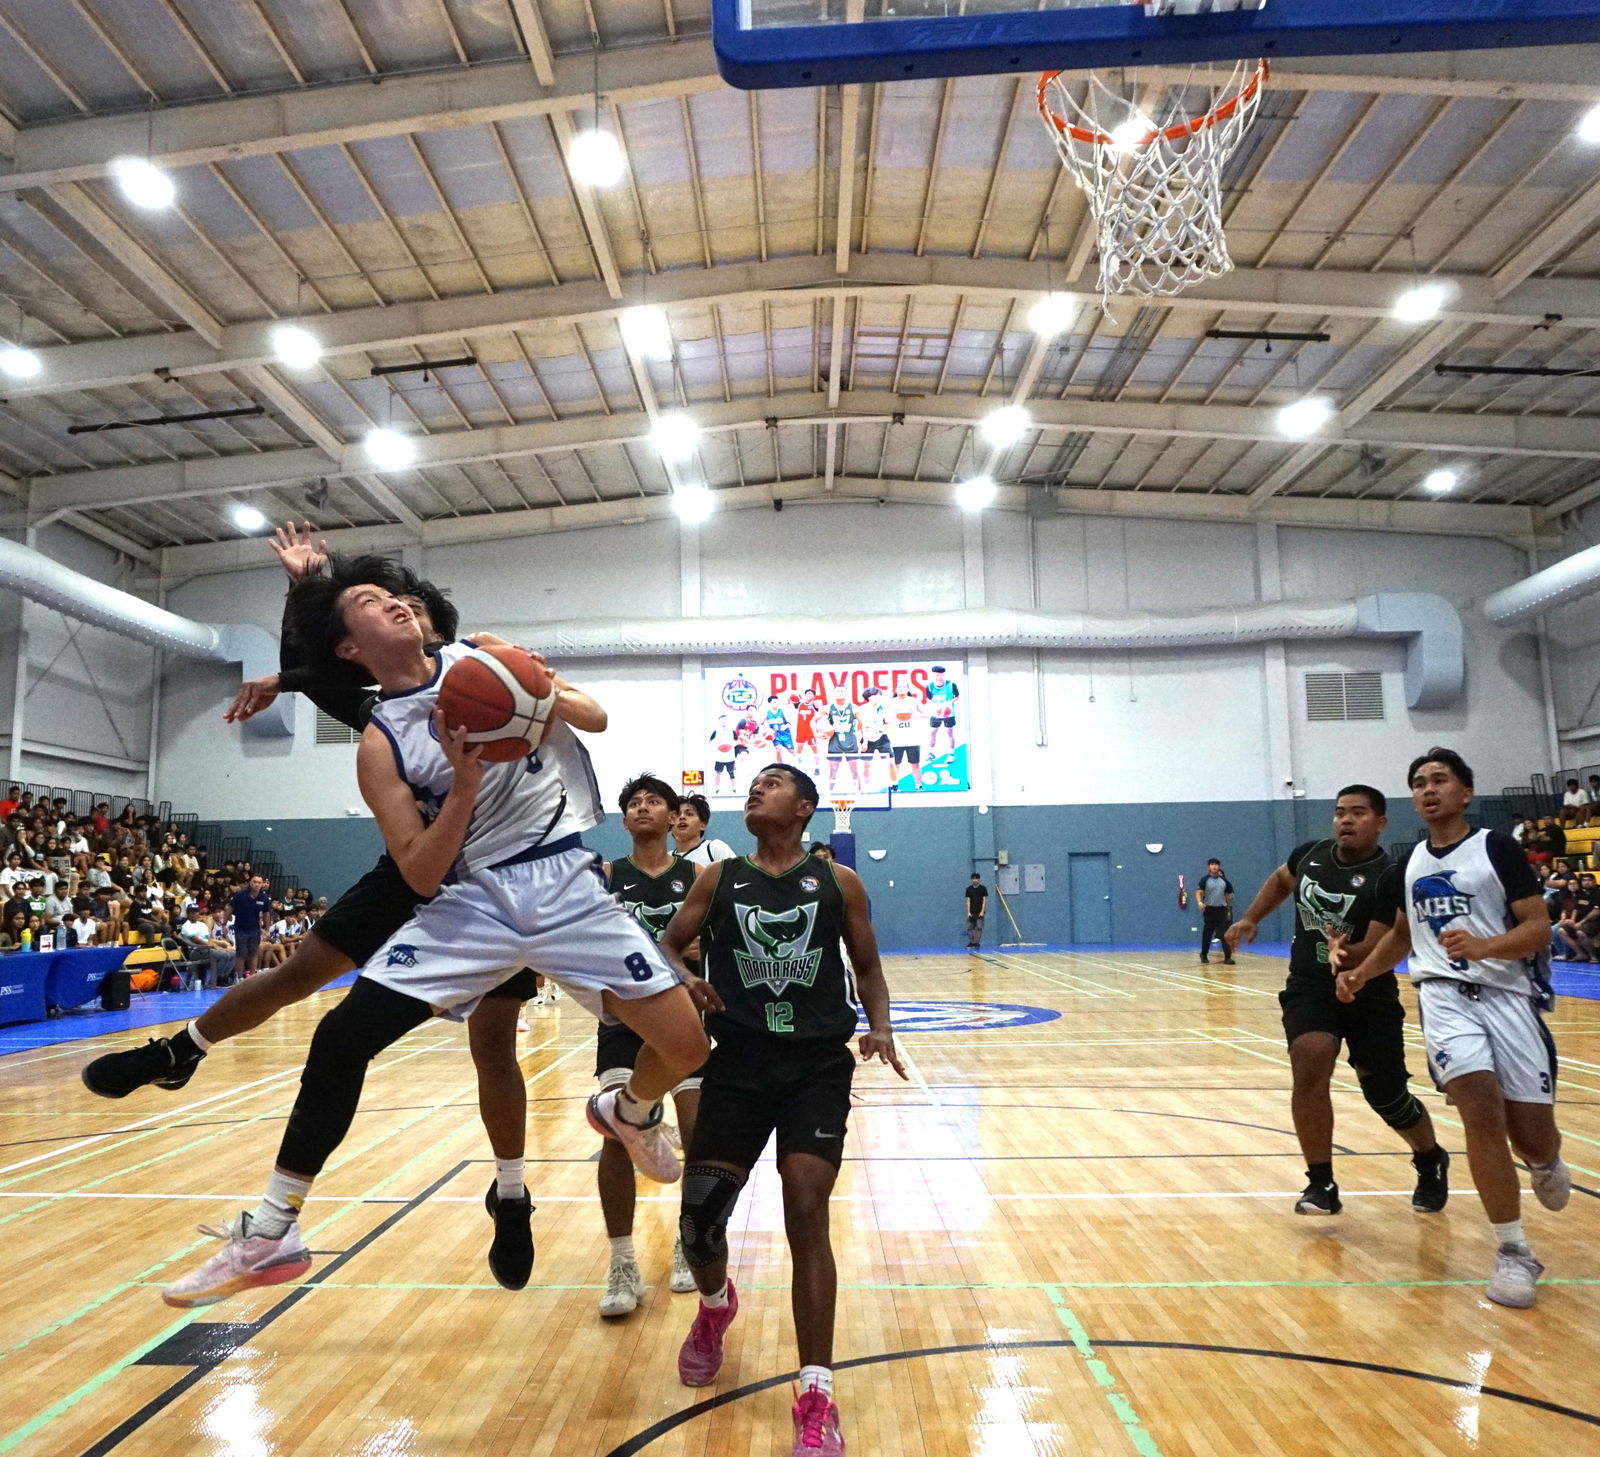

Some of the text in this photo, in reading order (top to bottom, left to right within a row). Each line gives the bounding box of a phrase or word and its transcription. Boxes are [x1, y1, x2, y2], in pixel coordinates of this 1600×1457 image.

[1414, 895, 1470, 922] MHS
[623, 951, 653, 982] 8
[740, 954, 817, 982] MANTA RAYS
[764, 1001, 795, 1033] 12
[1539, 1071, 1551, 1094] 3
